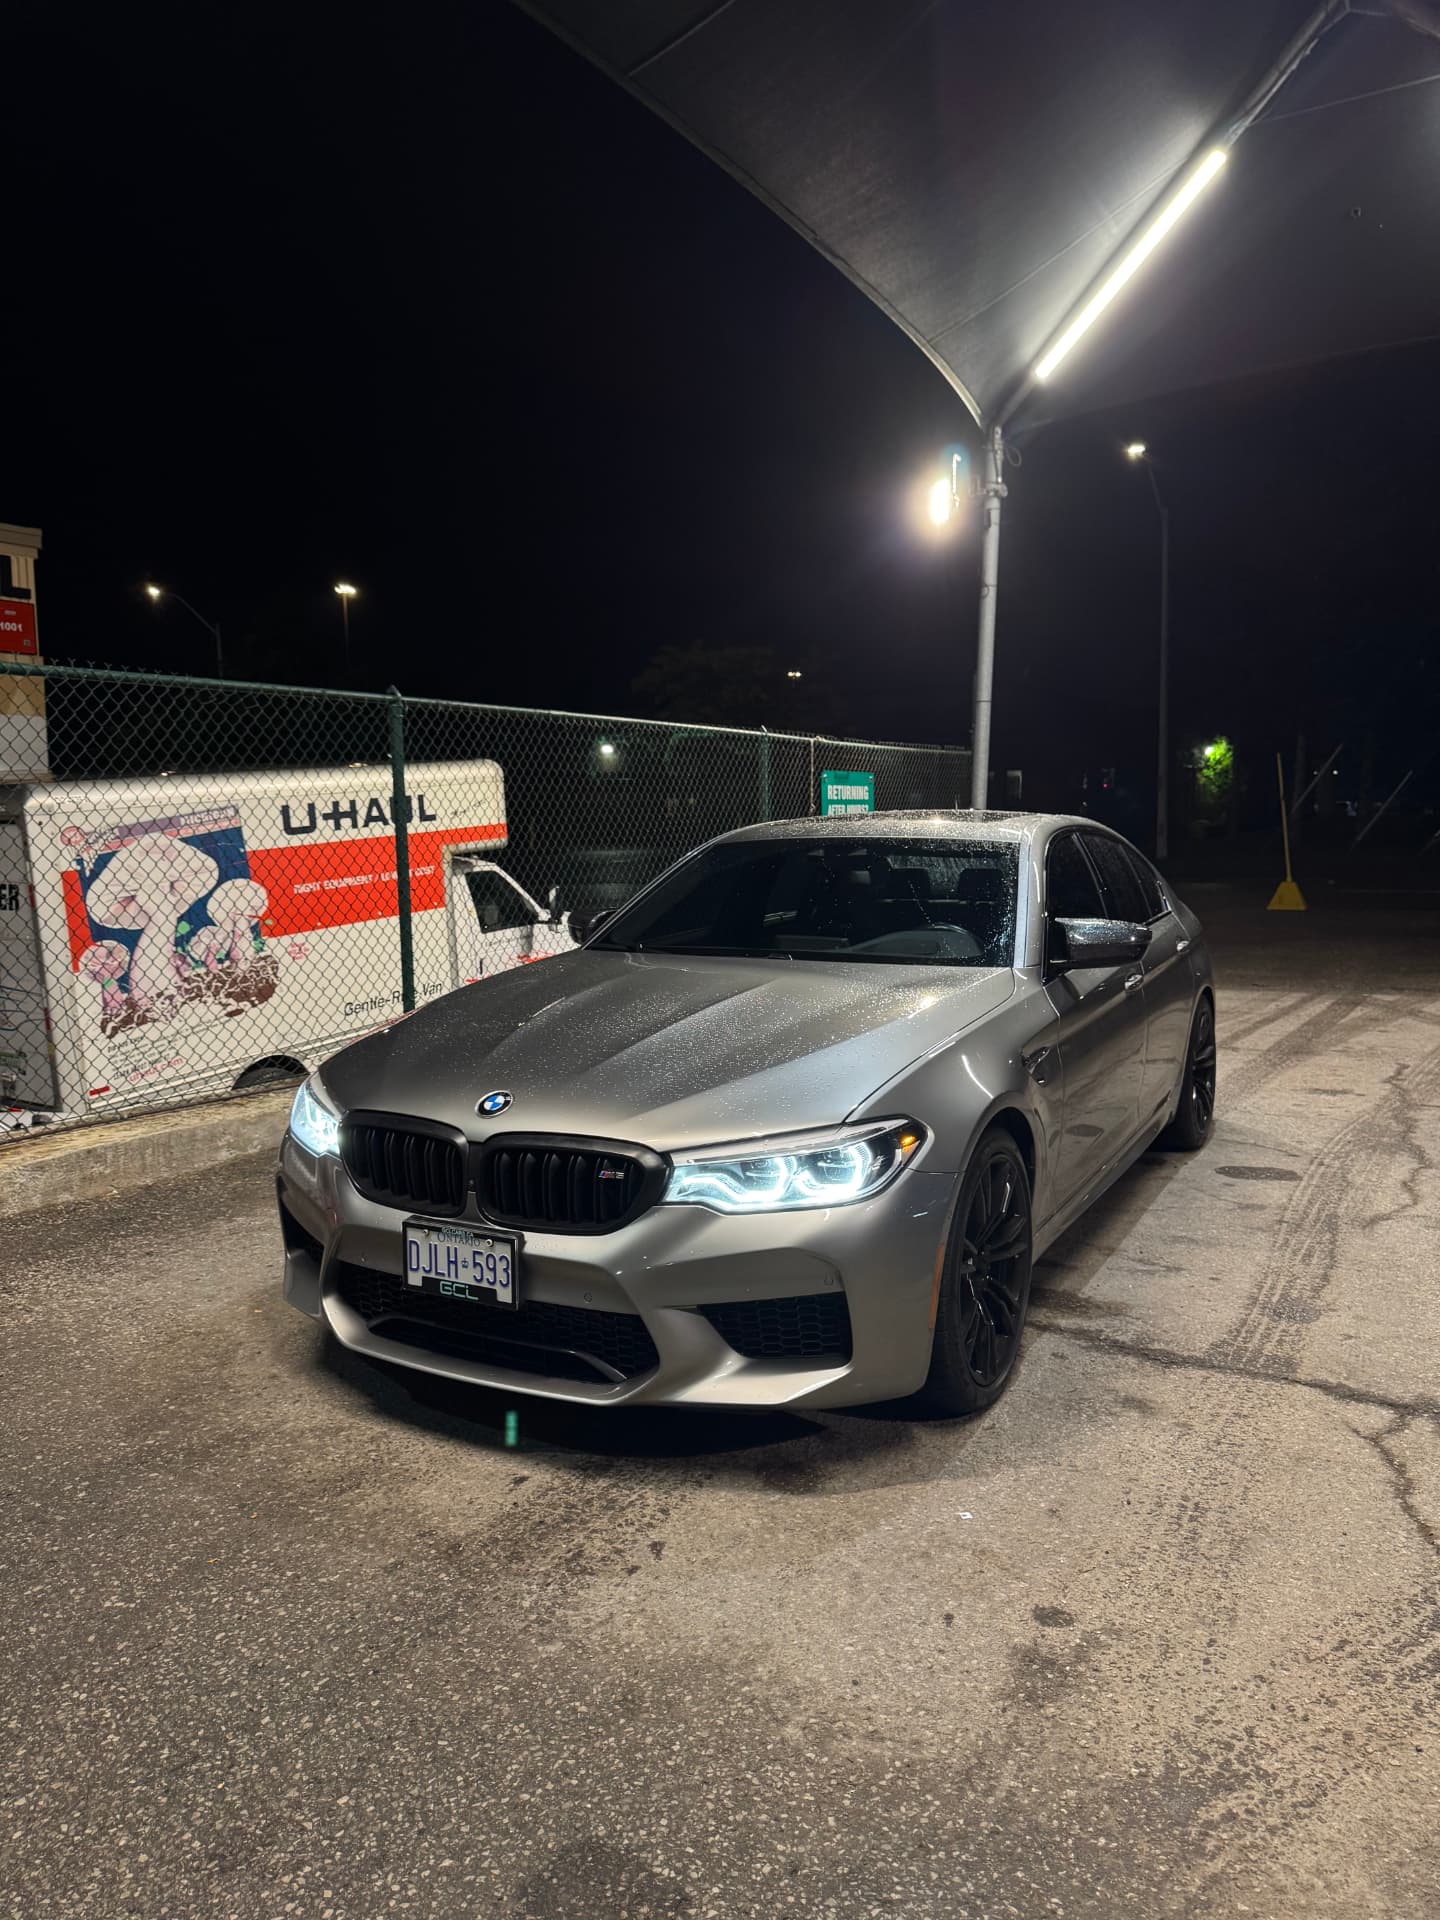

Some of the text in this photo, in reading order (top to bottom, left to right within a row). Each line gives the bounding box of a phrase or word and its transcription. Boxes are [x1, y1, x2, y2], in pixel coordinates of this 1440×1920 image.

[828, 785, 869, 800] RETURNING
[828, 804, 846, 816] AFTER
[294, 881, 320, 894] RIGHT
[324, 875, 373, 890] EQUIPMENT
[381, 868, 413, 882] LOWT
[415, 865, 435, 876] COST
[344, 983, 442, 1016] Gentle-Re Van
[408, 1240, 510, 1288] DJLH 593
